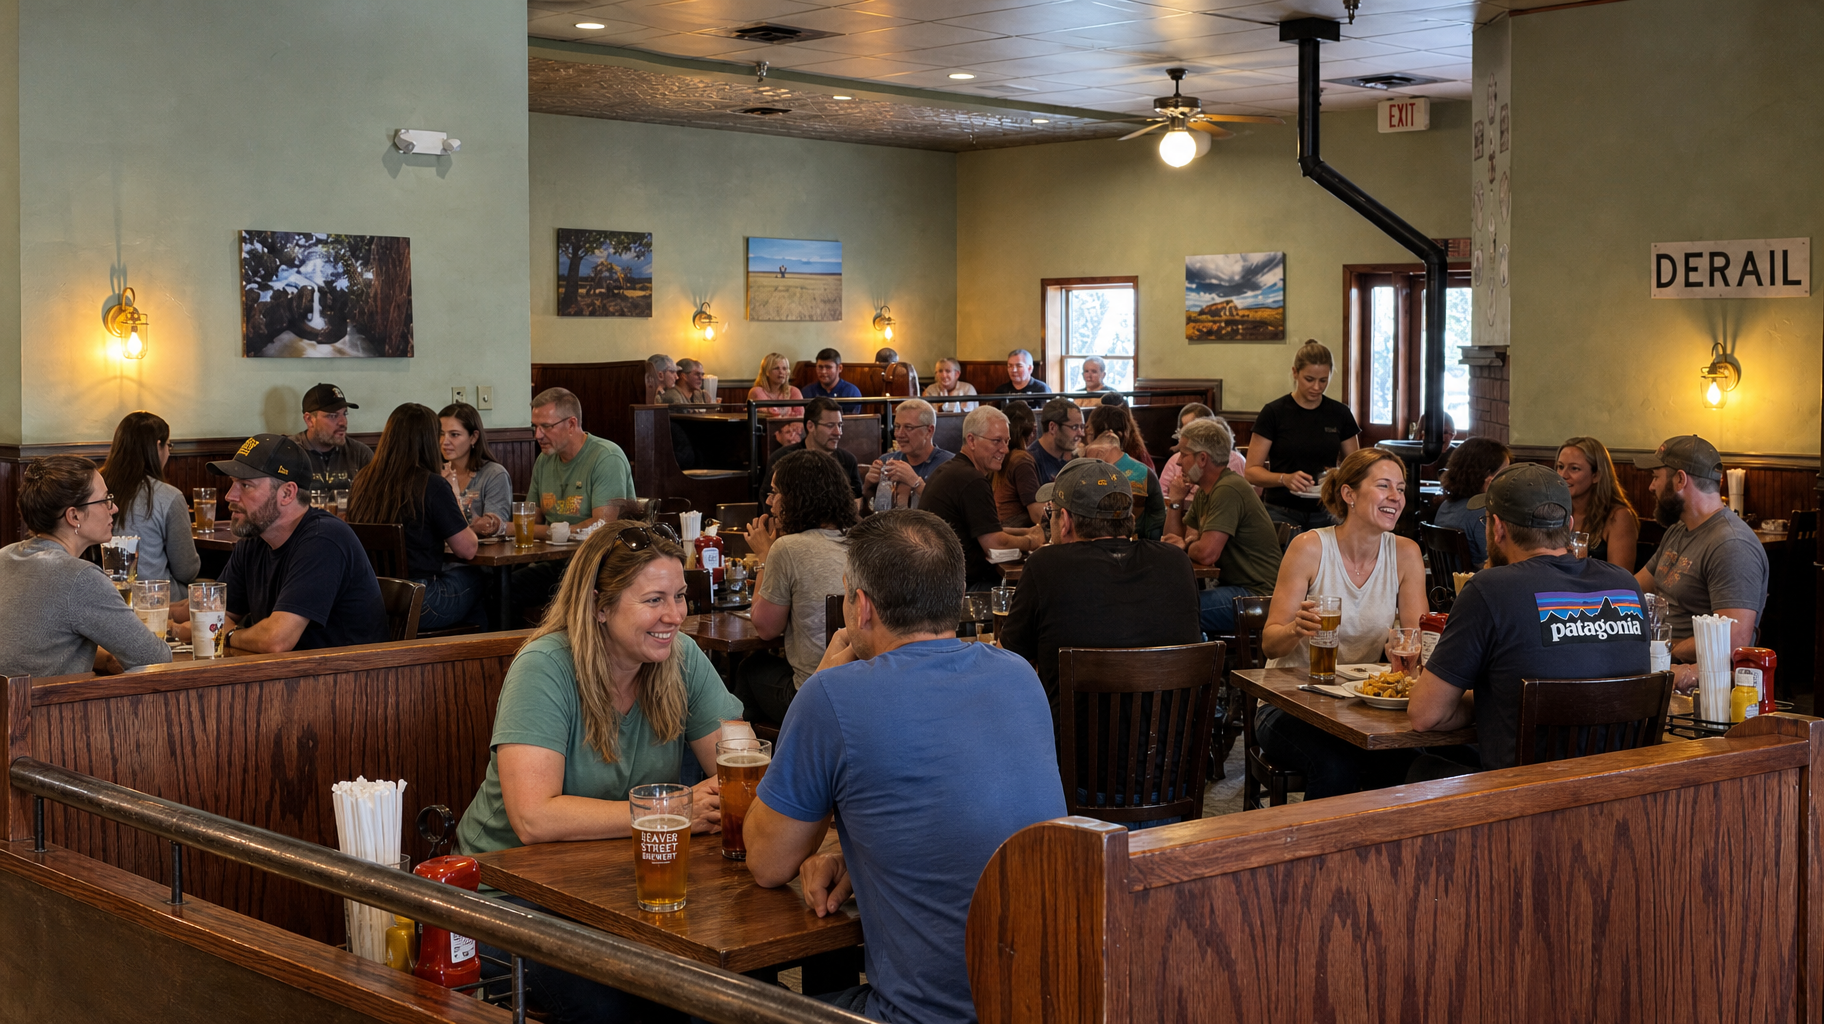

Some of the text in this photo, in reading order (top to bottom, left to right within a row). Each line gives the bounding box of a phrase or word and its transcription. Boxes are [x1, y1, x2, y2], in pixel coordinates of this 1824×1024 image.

[1389, 102, 1416, 128] EXIT
[1656, 249, 1802, 288] DERAIL
[1550, 617, 1641, 642] patagonia
[641, 831, 678, 843] BEAVER
[641, 842, 679, 853] STREET
